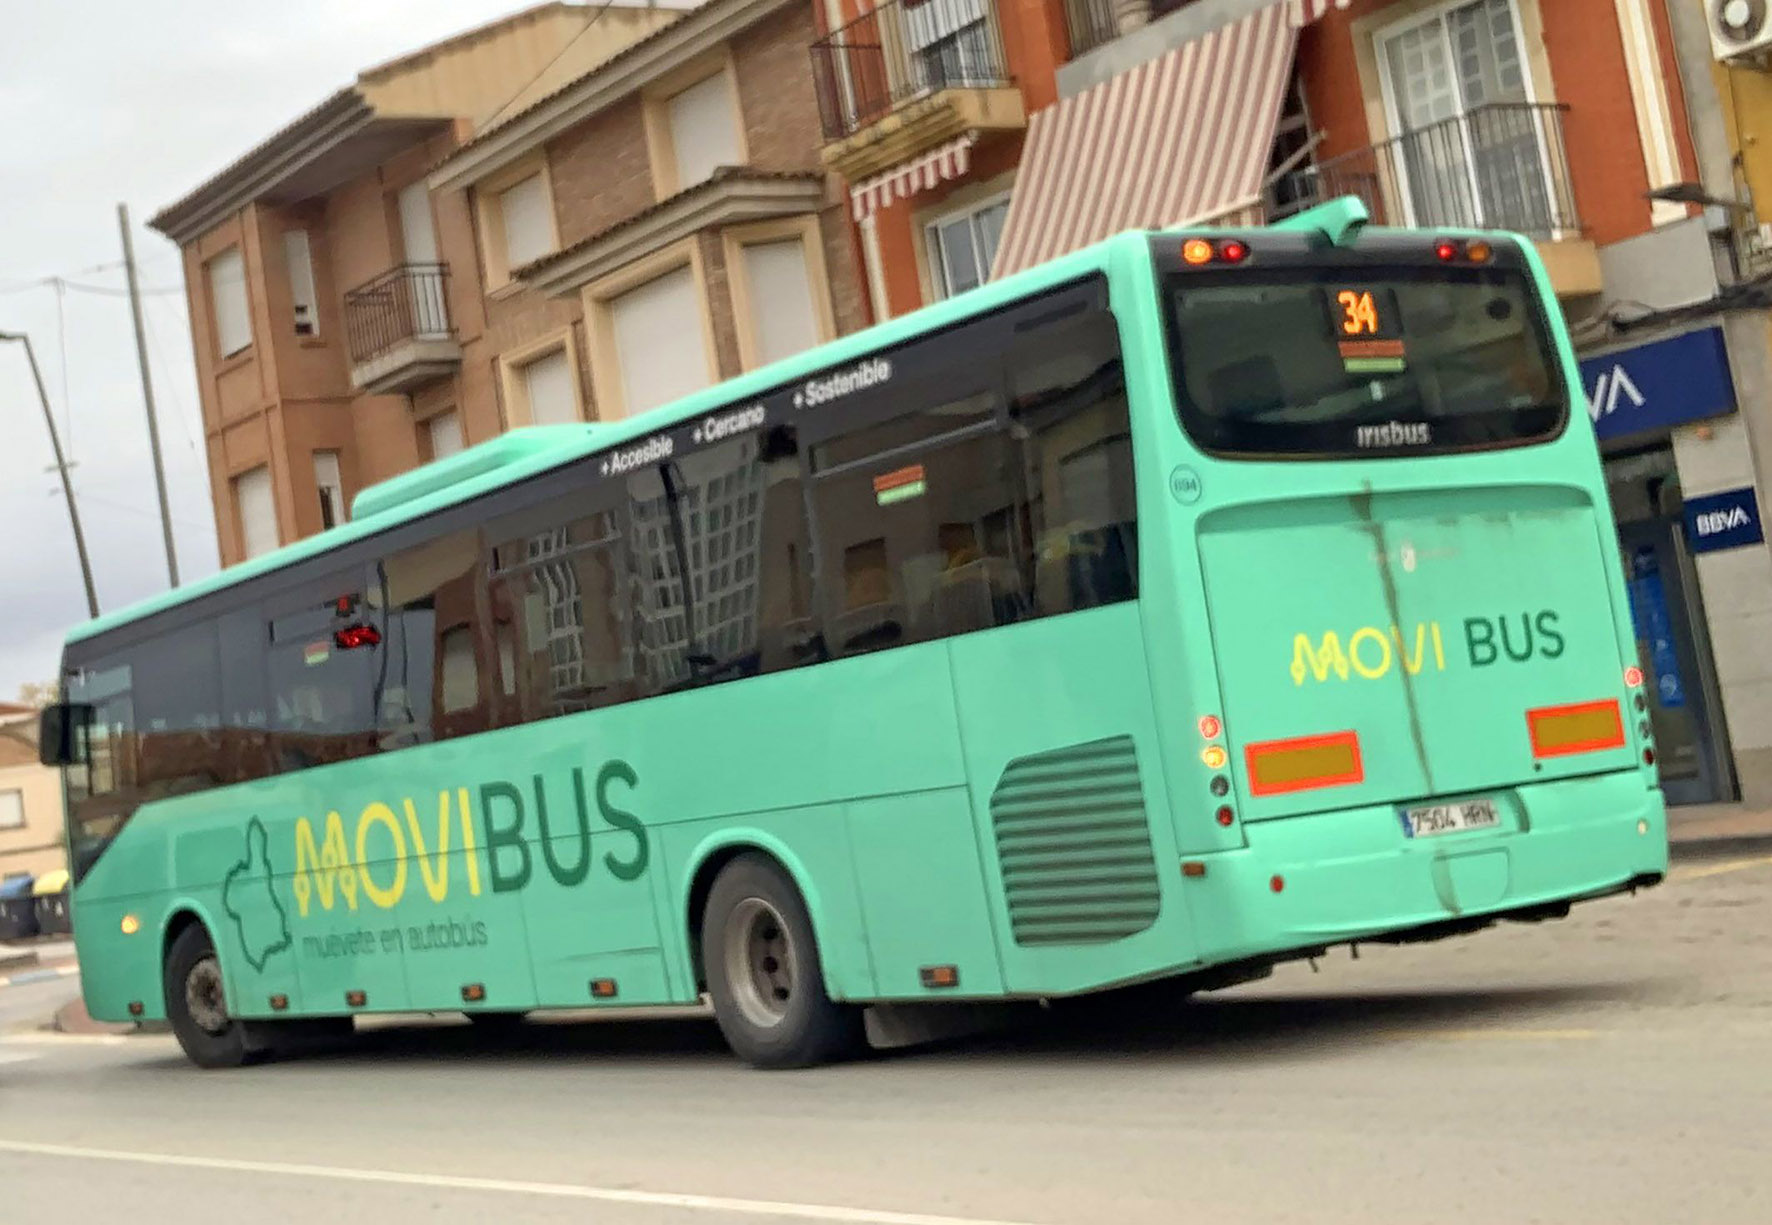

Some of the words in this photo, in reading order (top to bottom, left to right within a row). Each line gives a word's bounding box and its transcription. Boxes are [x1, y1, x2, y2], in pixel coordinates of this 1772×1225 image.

[1336, 289, 1378, 335] 34
[804, 357, 892, 408] Sostenible
[703, 405, 765, 442] Cercano
[611, 436, 674, 475] Accesible
[1696, 504, 1751, 536] BBVA
[1290, 620, 1445, 686] MOVI
[1463, 609, 1566, 668] BUS
[380, 927, 404, 955] en
